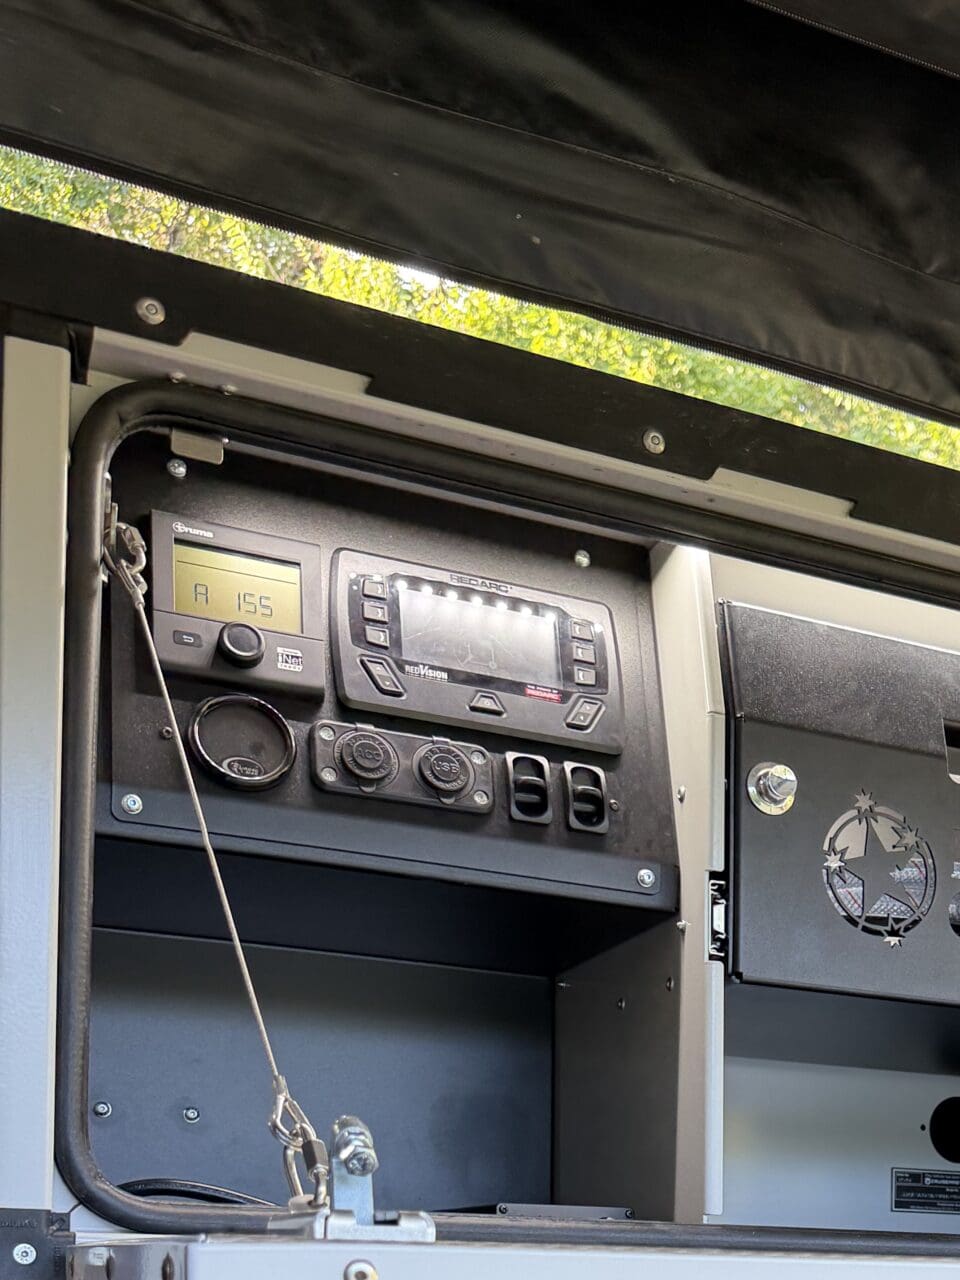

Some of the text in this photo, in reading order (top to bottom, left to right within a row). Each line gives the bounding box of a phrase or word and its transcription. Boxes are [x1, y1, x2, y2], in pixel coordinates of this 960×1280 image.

[450, 574, 510, 594] REDARC
[194, 582, 273, 618] A 155
